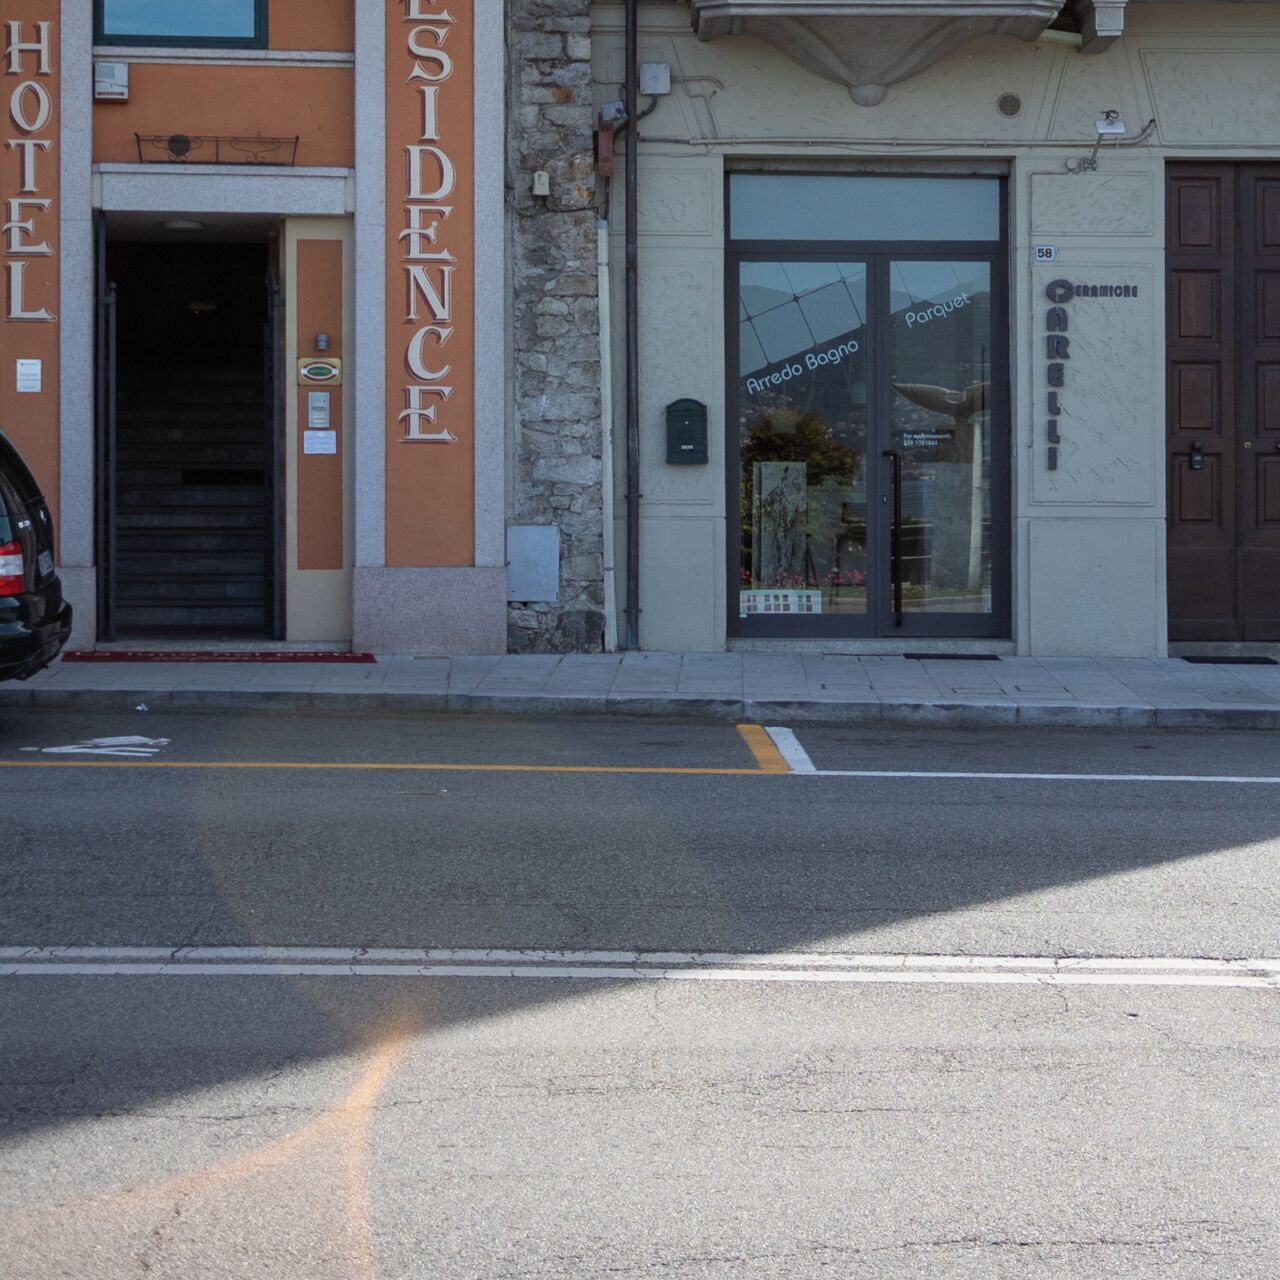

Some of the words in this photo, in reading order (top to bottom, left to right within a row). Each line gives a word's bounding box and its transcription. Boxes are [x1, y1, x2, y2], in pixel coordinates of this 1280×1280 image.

[2, 20, 57, 322] HOTEL
[1037, 247, 1053, 259] 58
[905, 291, 972, 328] Parquet
[746, 362, 803, 395] Arredo
[805, 340, 859, 370] Bagno
